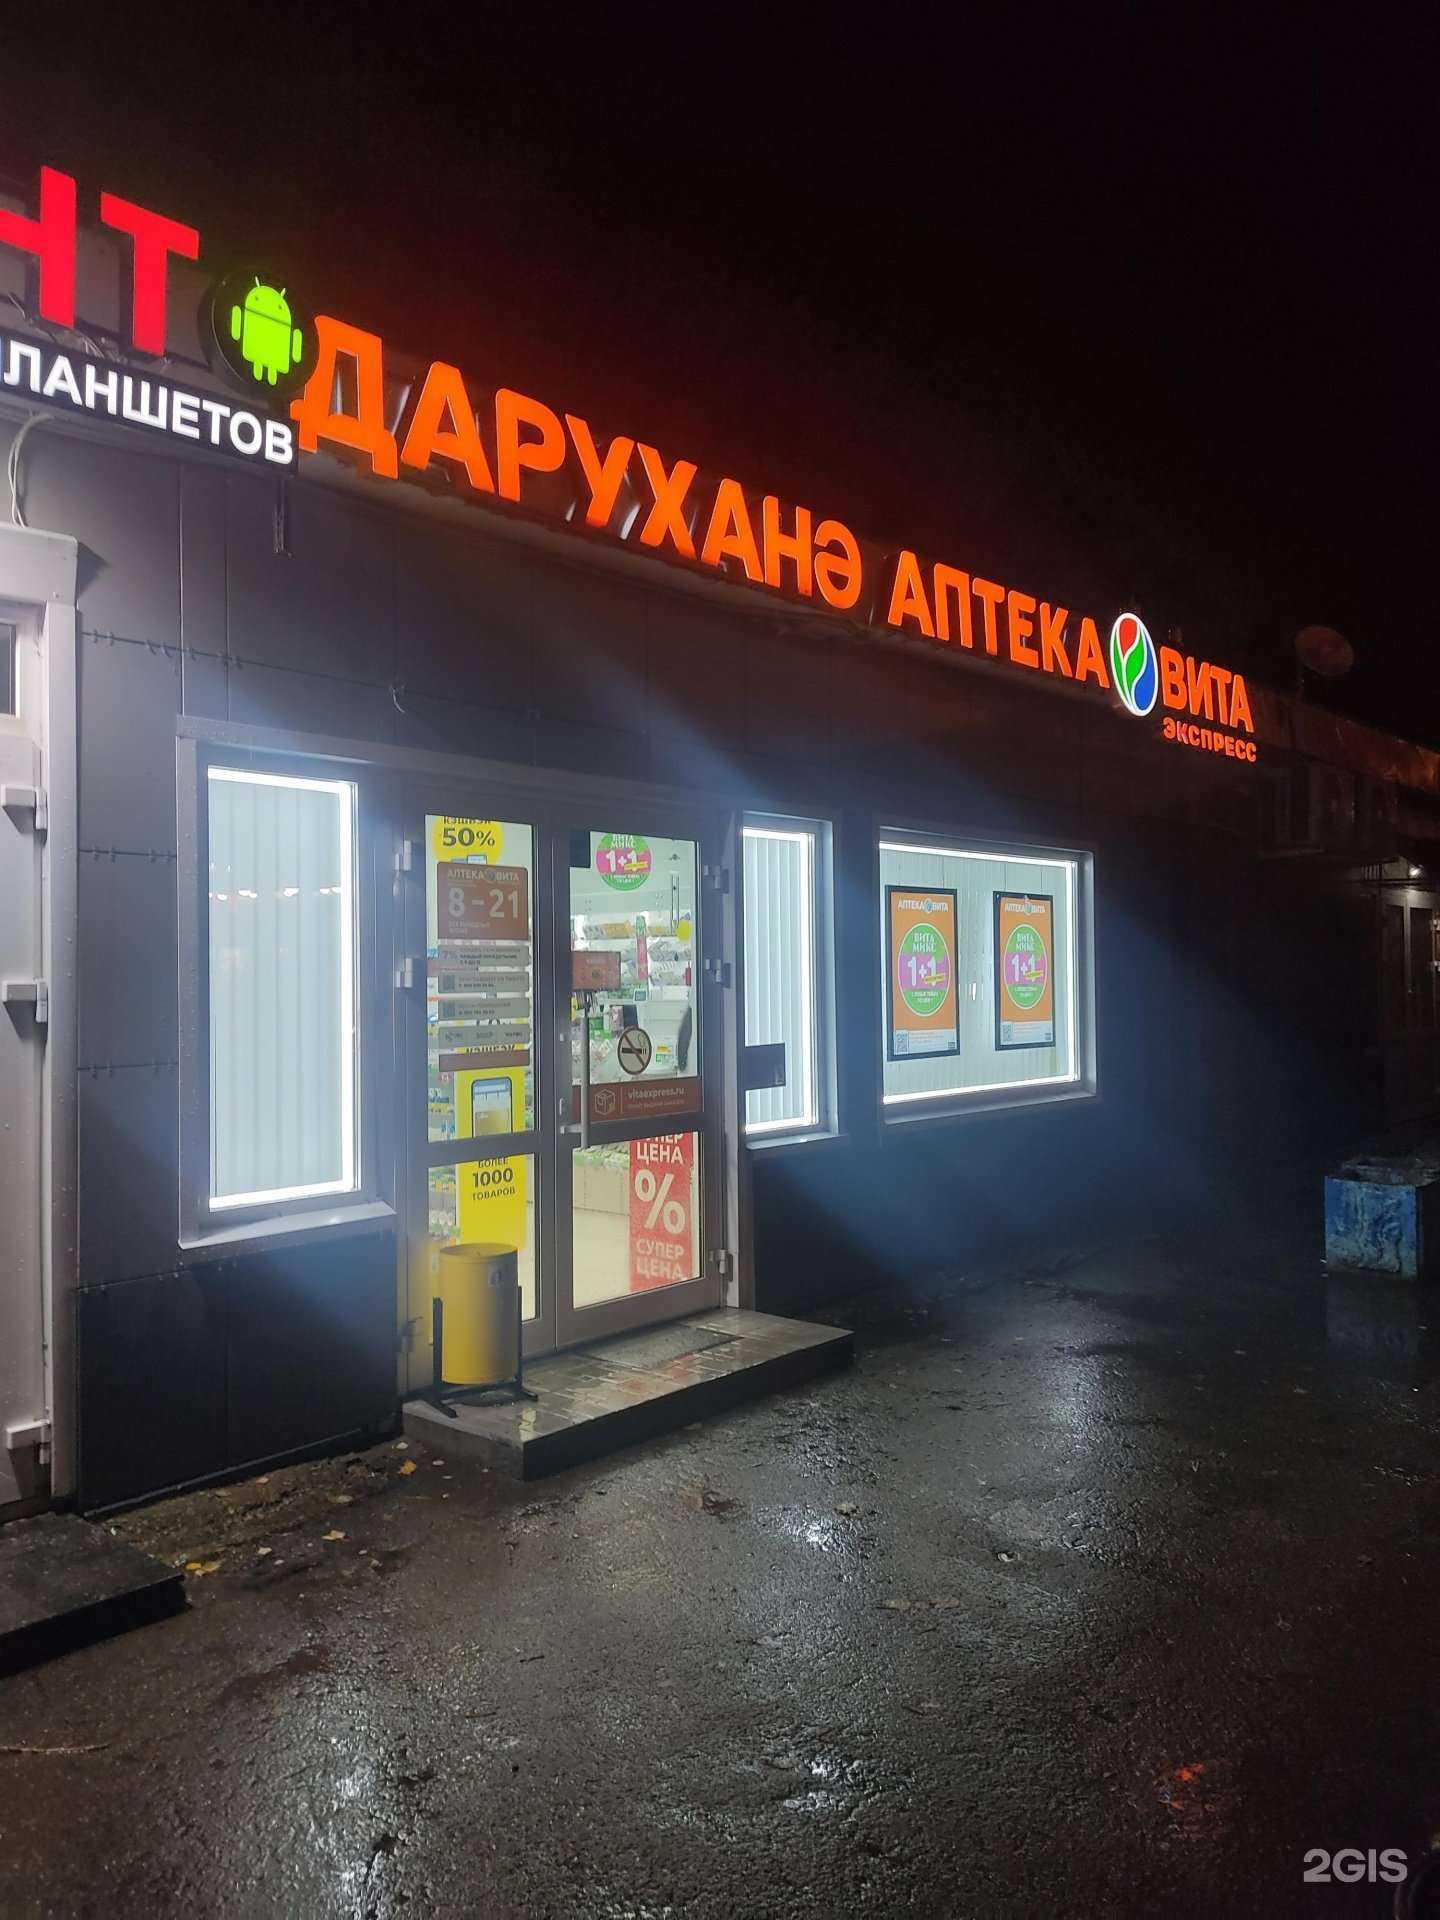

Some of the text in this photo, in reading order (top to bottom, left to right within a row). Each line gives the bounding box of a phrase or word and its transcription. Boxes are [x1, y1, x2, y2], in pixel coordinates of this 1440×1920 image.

[0, 337, 294, 466] ЛАНШЕТОВ
[290, 314, 1255, 733] ДАРУХАНӘ АПТЕКА ВИТА
[1162, 716, 1257, 762] ЭКСПРЕСС
[443, 827, 495, 847] 50%
[447, 869, 520, 881] АПТЕКА ВИТА
[898, 900, 923, 912] АПТЕКА
[907, 956, 937, 987] 1+1
[1011, 954, 1036, 982] 1+1
[637, 1141, 684, 1165] ЦЕНА
[472, 1167, 514, 1188] 1000
[472, 1186, 516, 1200] ТОВАРОВ
[636, 1238, 685, 1260] СУПЕР
[636, 1256, 683, 1280] ЦЕНА
